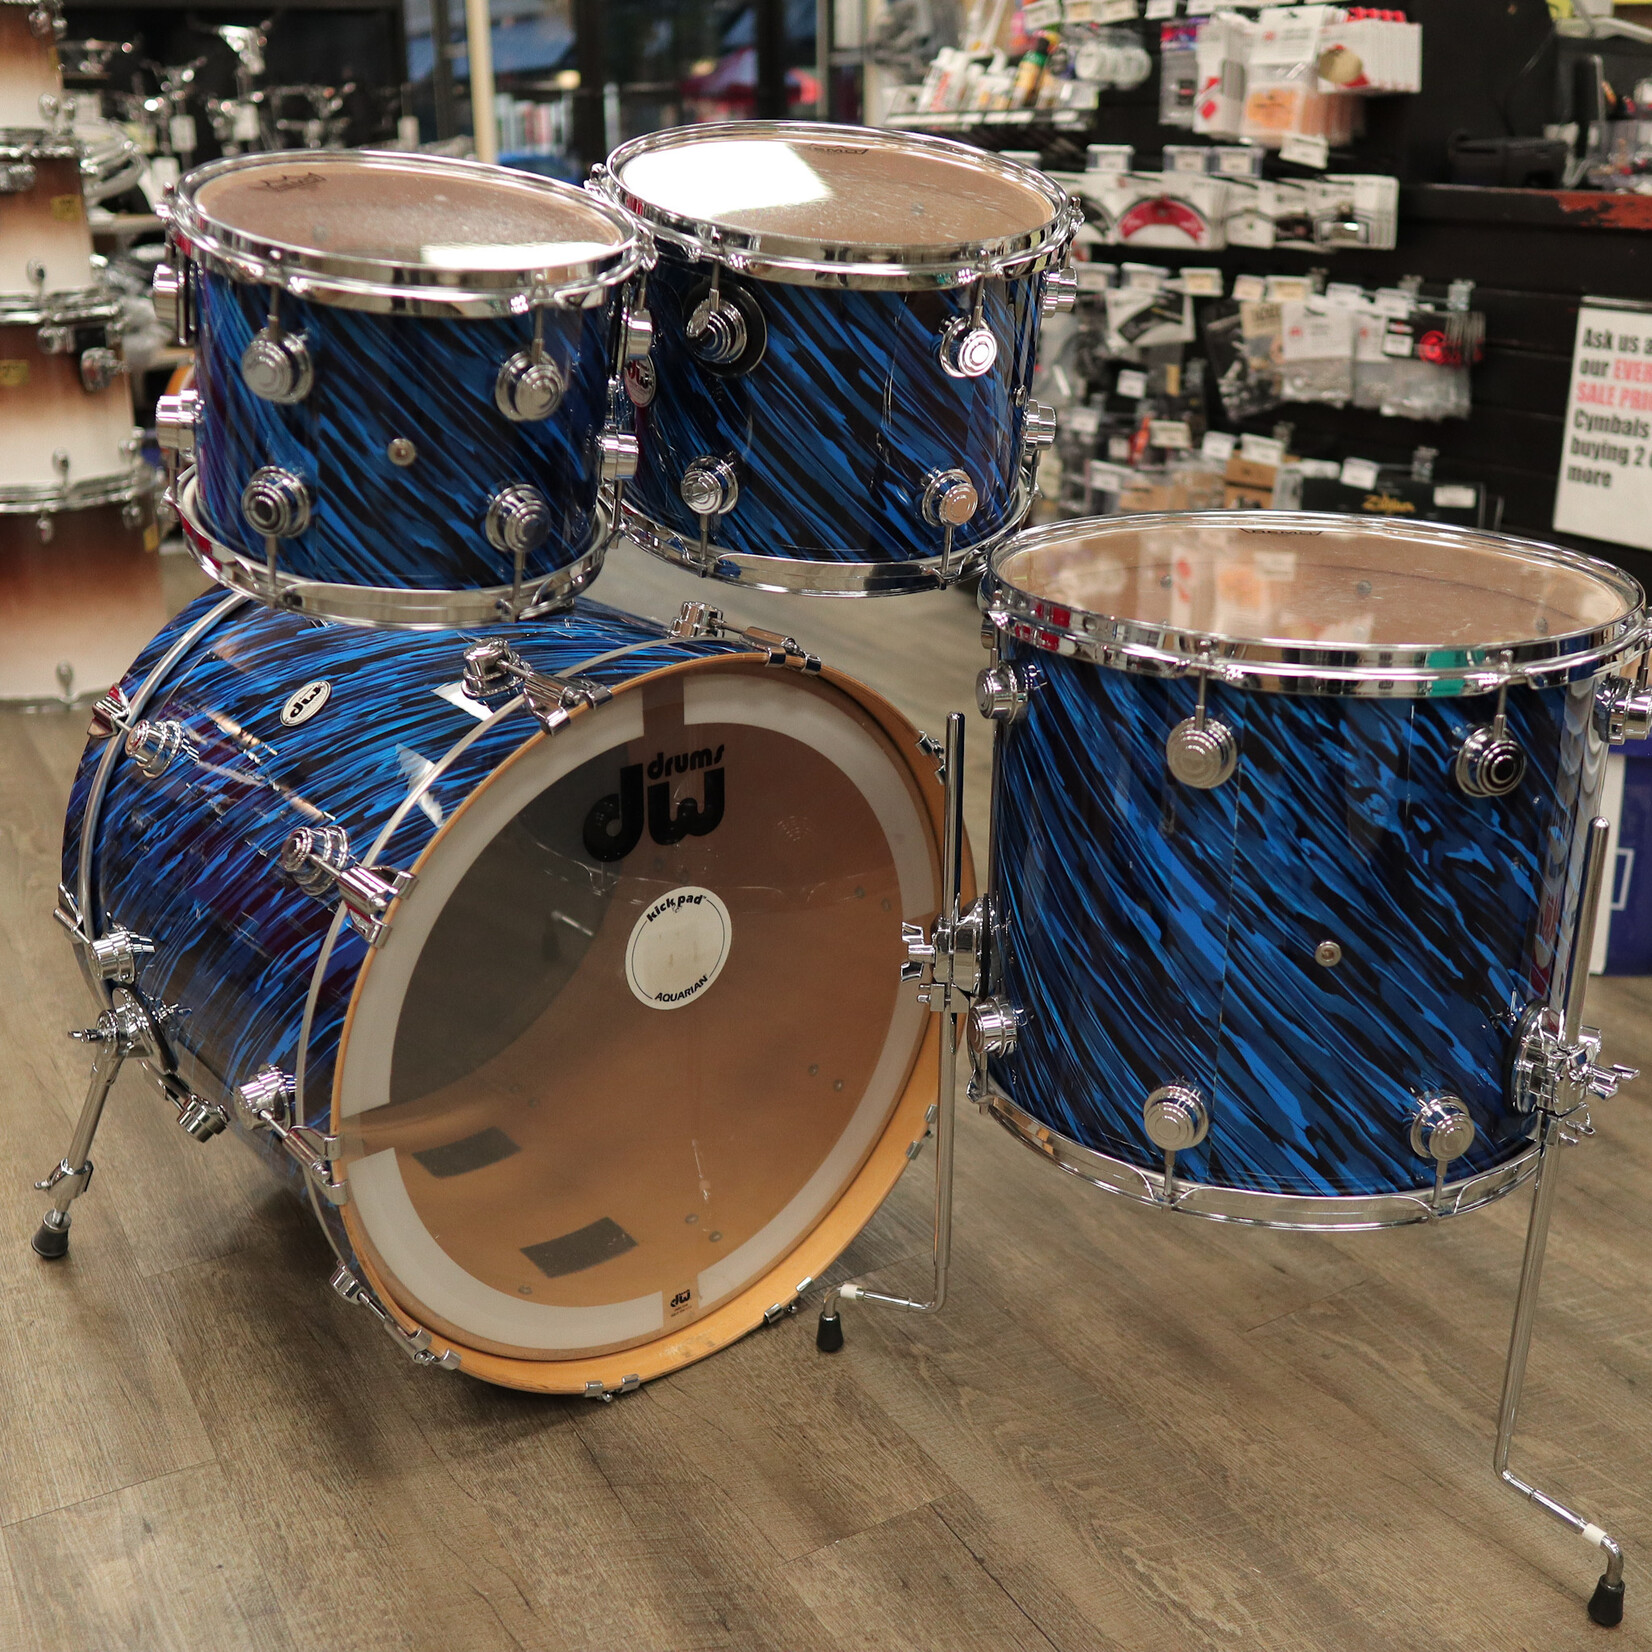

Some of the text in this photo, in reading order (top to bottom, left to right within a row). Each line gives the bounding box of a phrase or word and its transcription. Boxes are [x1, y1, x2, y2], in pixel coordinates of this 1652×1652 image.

[1583, 328, 1613, 351] Ask
[1618, 333, 1639, 354] us
[1579, 357, 1609, 377] our
[1576, 381, 1615, 407] SALE
[1573, 407, 1649, 439] Cymbals
[1570, 437, 1629, 467] buying
[1633, 446, 1645, 467] 2
[1567, 464, 1613, 488] more
[647, 744, 725, 780] drums
[583, 763, 725, 862] dw
[654, 975, 709, 1002] AQUARIAN
